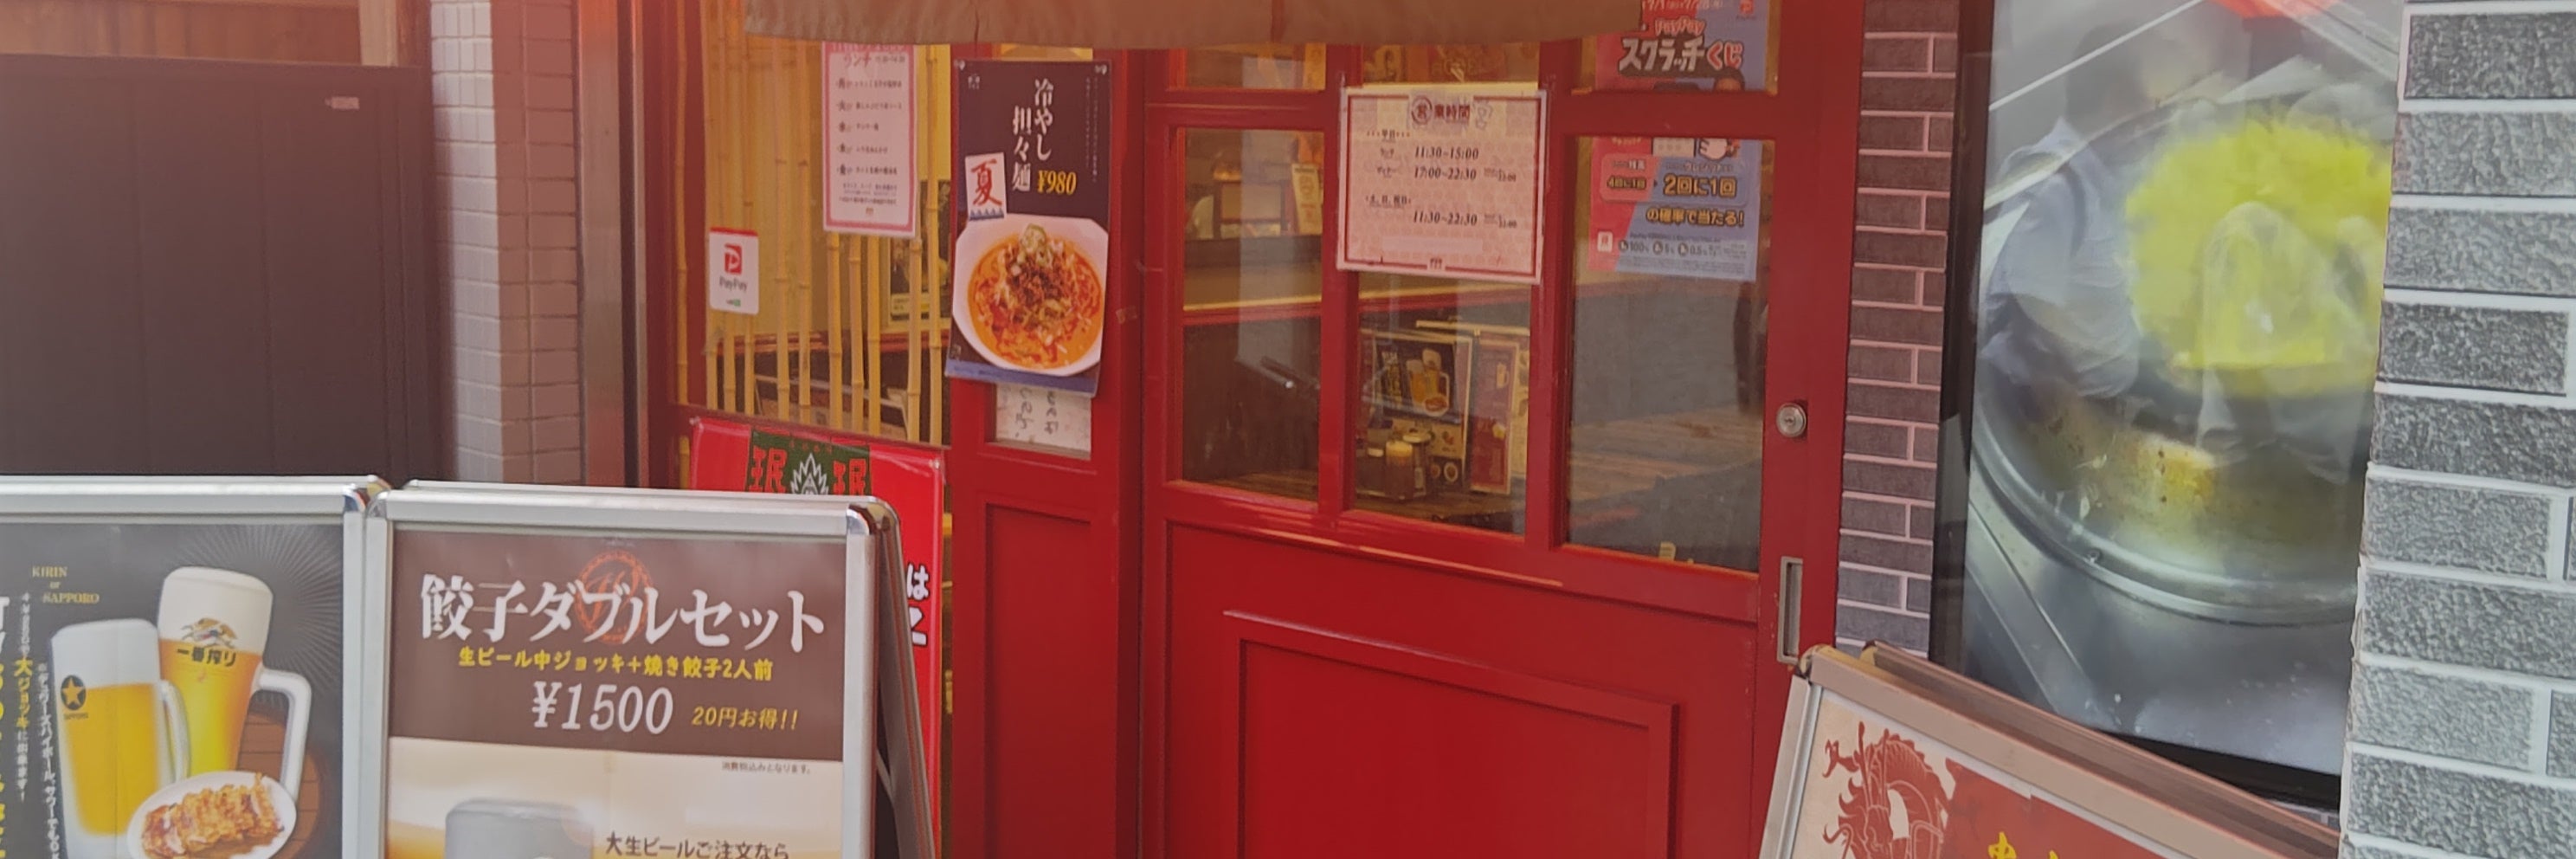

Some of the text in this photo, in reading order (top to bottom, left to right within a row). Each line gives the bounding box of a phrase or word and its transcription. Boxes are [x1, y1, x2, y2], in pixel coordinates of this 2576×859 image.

[1618, 36, 1743, 71] スクラッチくじ
[1034, 78, 1054, 161] 冷やし
[1012, 105, 1032, 192] 担々麺
[970, 158, 1003, 206] 夏
[1037, 170, 1077, 195] ¥980
[1663, 176, 1737, 198] 2回に1回
[32, 565, 68, 578] KIRIN
[42, 591, 100, 604] SAPPORO
[420, 573, 825, 653] 餃子ダブルセット
[531, 680, 674, 735] ¥1500
[605, 830, 790, 859] 大生ビールご注文なら
